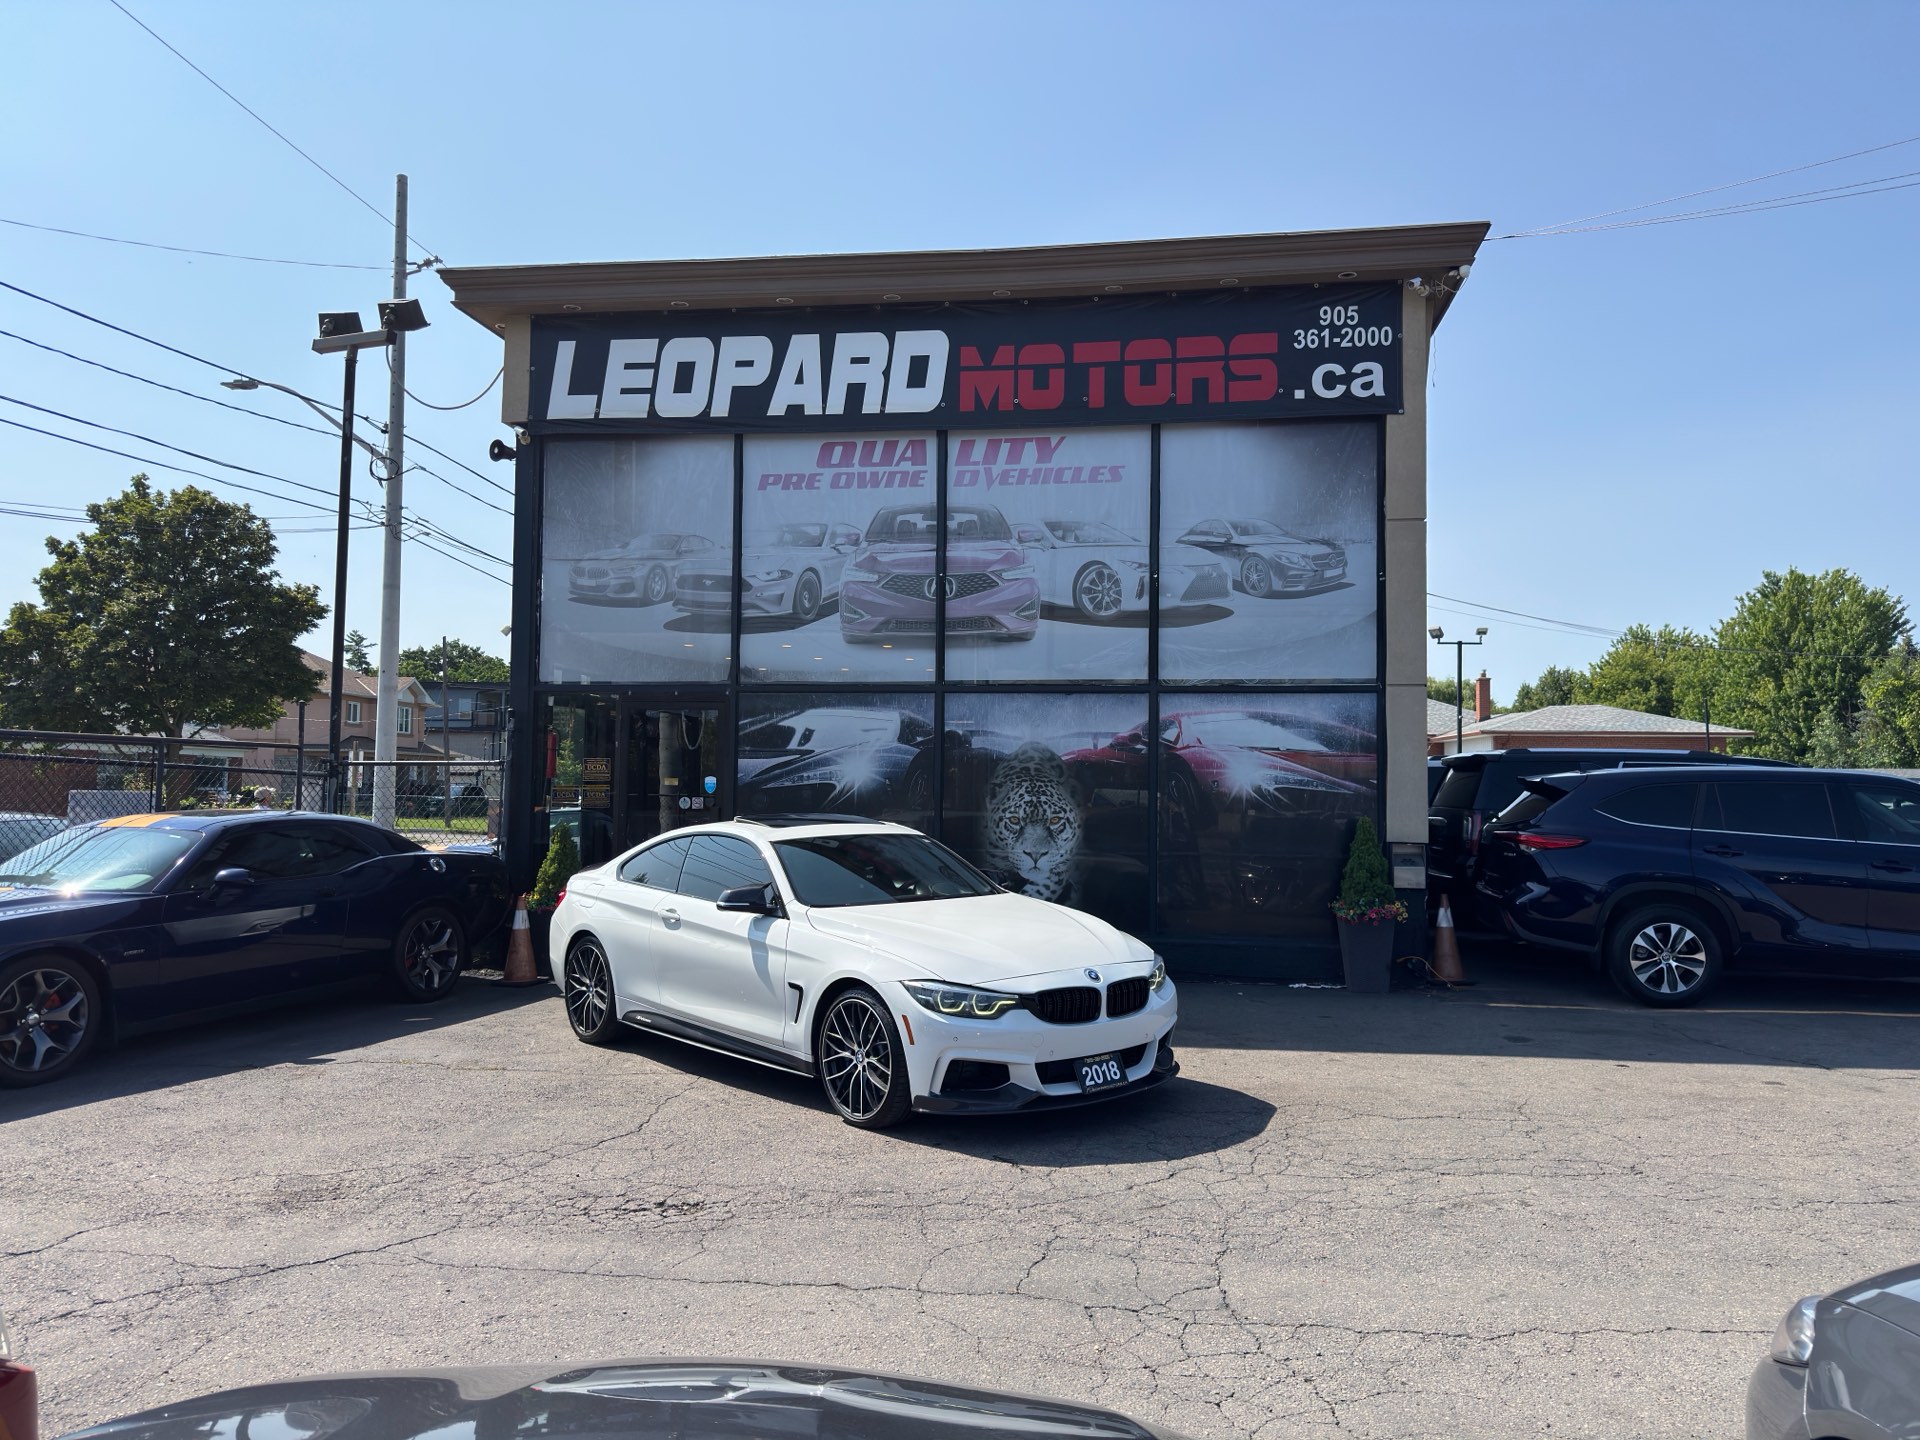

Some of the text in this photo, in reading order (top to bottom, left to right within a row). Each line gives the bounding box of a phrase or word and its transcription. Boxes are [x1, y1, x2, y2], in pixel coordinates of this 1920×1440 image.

[1319, 306, 1359, 326] 905
[1293, 327, 1393, 349] 361-2000
[547, 330, 1278, 419] LEOPARD MOTORS
[1294, 360, 1386, 399] .ca
[758, 472, 821, 491] PRE
[1082, 1060, 1120, 1087] 2018
